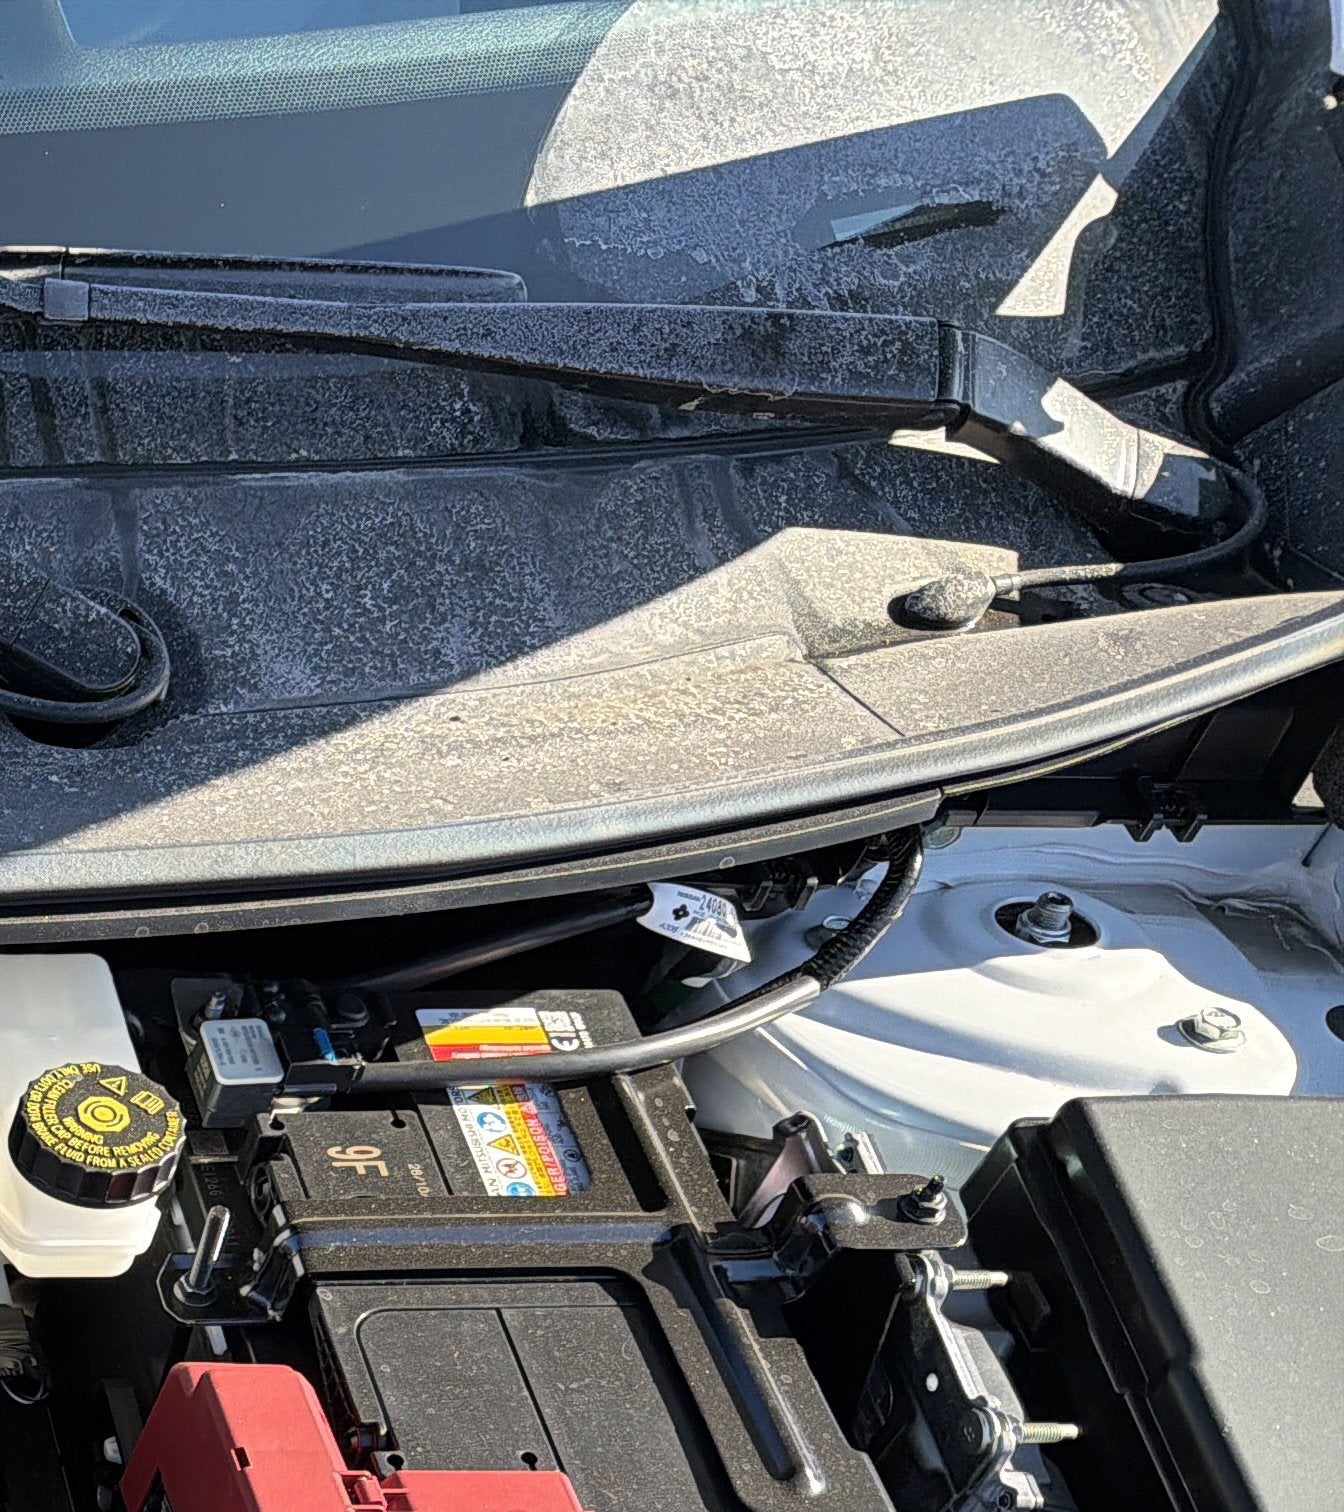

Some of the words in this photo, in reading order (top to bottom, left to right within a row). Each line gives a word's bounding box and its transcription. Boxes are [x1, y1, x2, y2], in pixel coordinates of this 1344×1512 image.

[52, 1065, 80, 1079] ONLY
[81, 1063, 101, 1074] USE
[46, 1079, 73, 1100] CLEAN
[42, 1098, 60, 1125] FILLER
[32, 1122, 59, 1146] BRAKE
[50, 1124, 72, 1141] CAP
[62, 1116, 104, 1145] WARNING
[158, 1111, 180, 1152] CONTAINER
[55, 1143, 85, 1162] FLUID
[68, 1137, 111, 1157] BEFORE
[112, 1131, 160, 1156] REMOVING
[86, 1154, 117, 1168] FROM
[127, 1146, 163, 1167] SEALED
[326, 1145, 390, 1177] 9F
